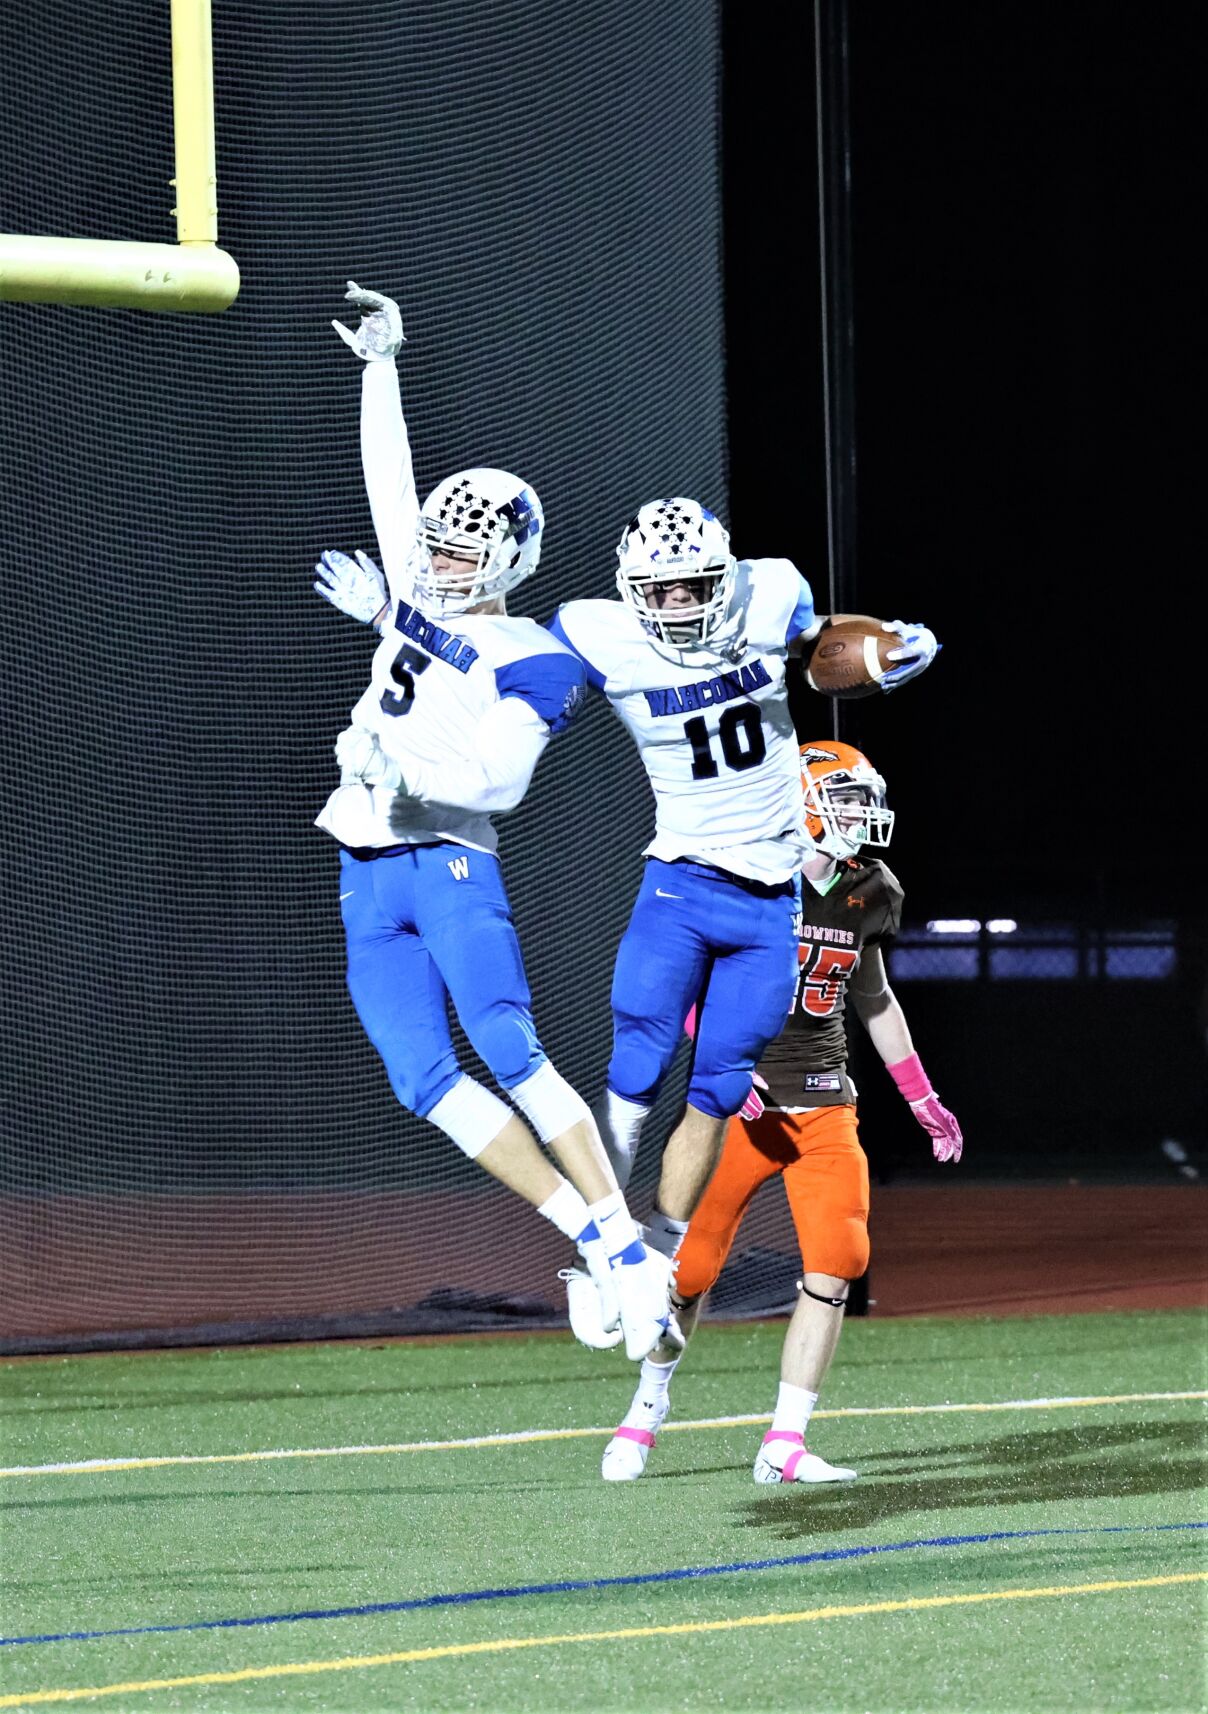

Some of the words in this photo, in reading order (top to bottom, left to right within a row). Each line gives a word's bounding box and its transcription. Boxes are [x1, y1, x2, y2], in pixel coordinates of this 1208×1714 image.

[379, 642, 433, 718] 5
[643, 658, 774, 718] WAHCONAH
[683, 701, 767, 781] 10
[447, 855, 469, 881] W
[799, 924, 855, 945] OWNIES
